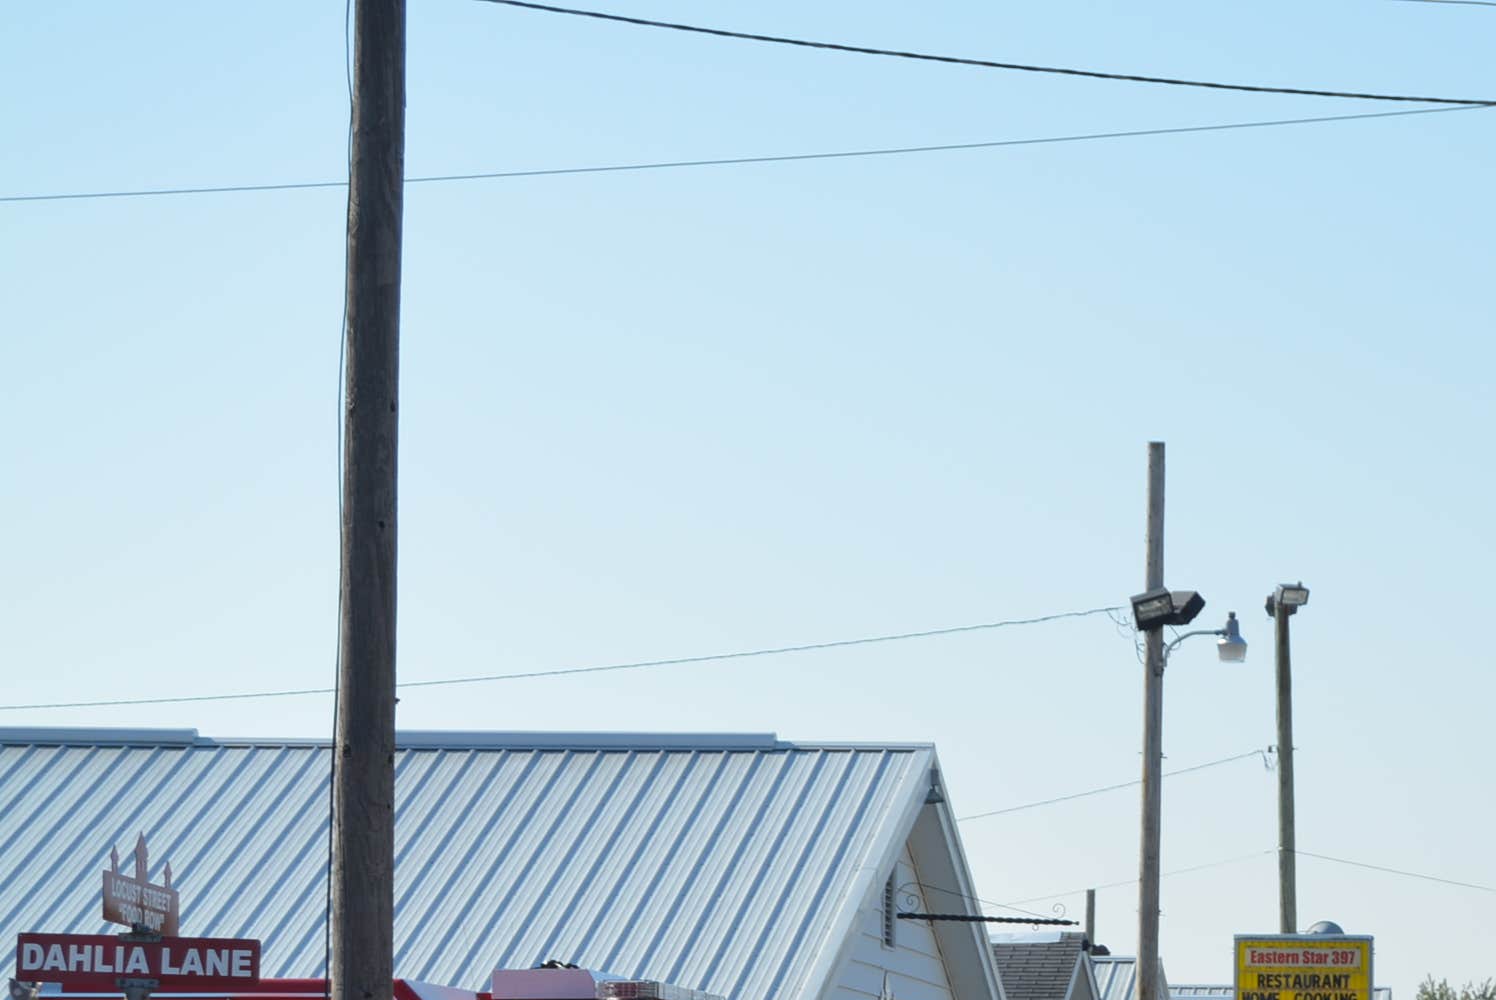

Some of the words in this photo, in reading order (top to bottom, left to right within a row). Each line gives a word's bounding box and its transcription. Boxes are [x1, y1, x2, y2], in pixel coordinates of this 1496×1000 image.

[112, 877, 142, 905] LOCUST
[143, 887, 172, 912] STREET
[22, 943, 150, 974] DAHLIA
[161, 947, 253, 977] LANE
[1250, 950, 1299, 964] Eastern
[1302, 950, 1329, 964] Star
[1331, 950, 1356, 965] 397
[1257, 974, 1350, 989] RESTAURANT
